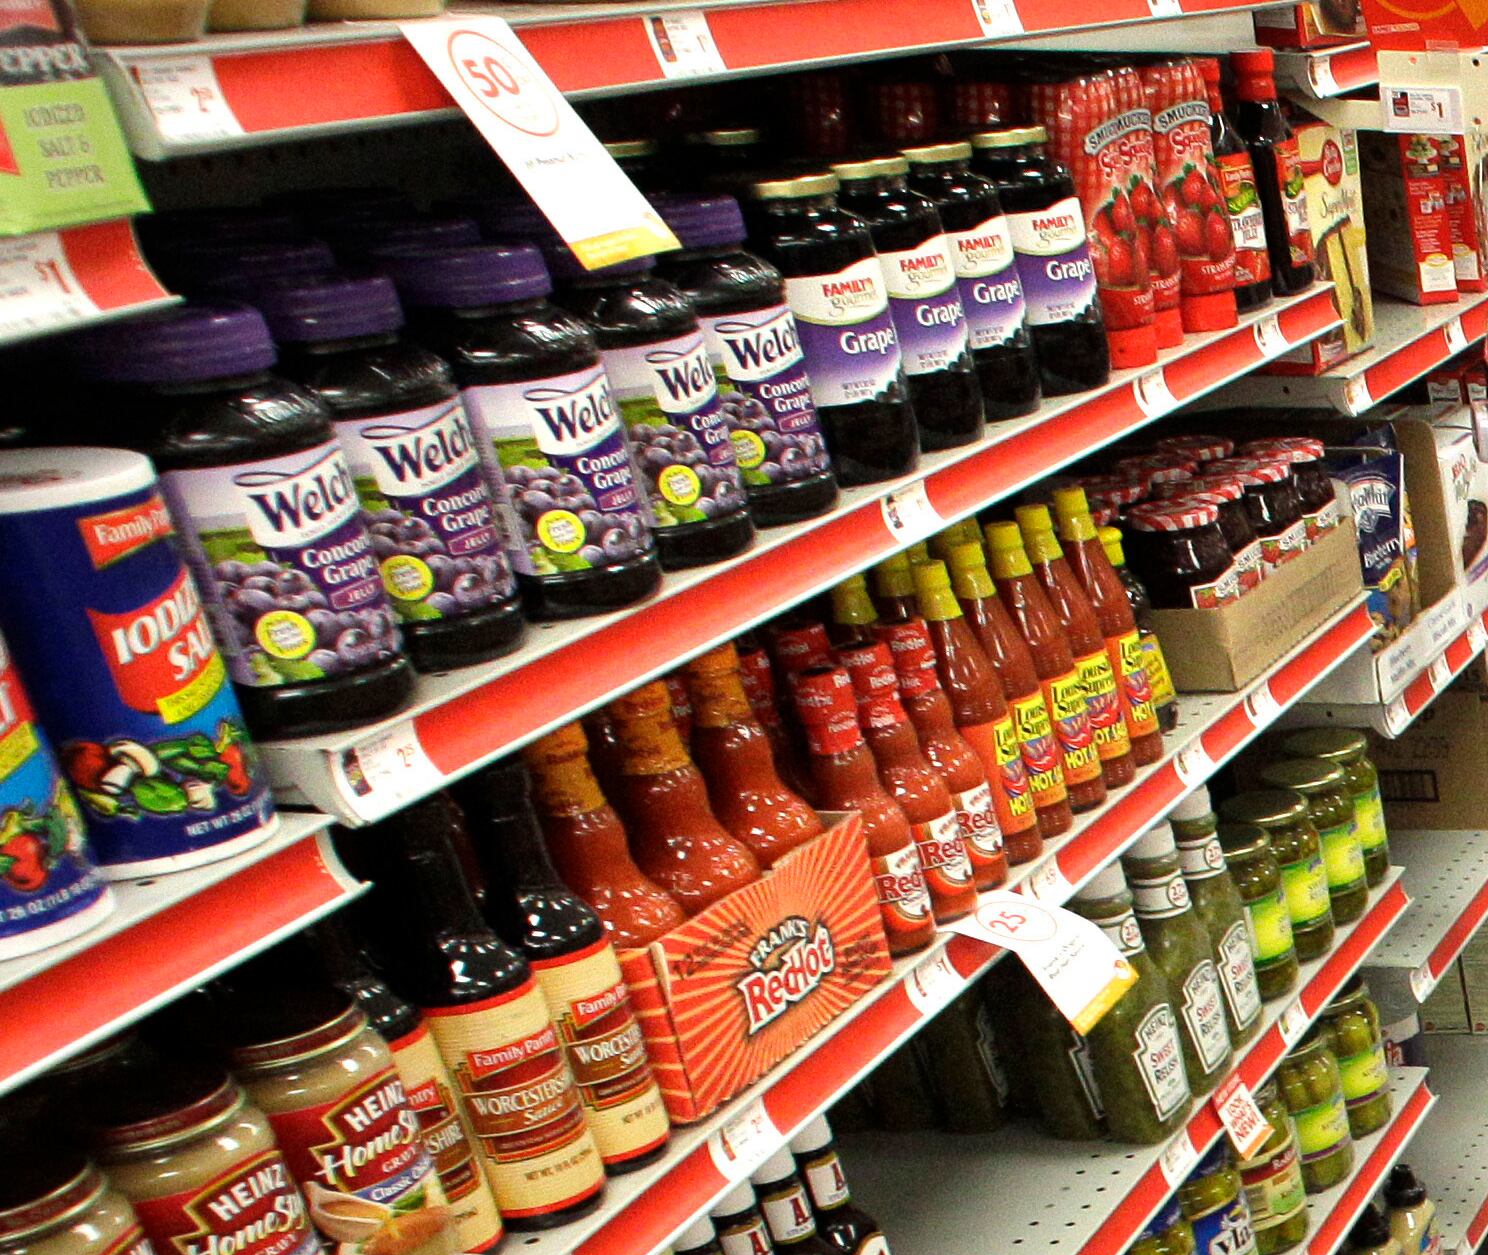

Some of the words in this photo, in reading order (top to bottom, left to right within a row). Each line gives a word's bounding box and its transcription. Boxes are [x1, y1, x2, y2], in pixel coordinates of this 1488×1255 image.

[1047, 259, 1092, 280] Grape
[974, 282, 1020, 303] Grape
[916, 303, 961, 327] Grape
[841, 326, 893, 355] Grape
[95, 513, 151, 544] Family
[750, 919, 809, 967] FRANK'S
[578, 994, 615, 1015] Family
[473, 1044, 524, 1069] Family
[209, 1164, 286, 1220] HEINZ
